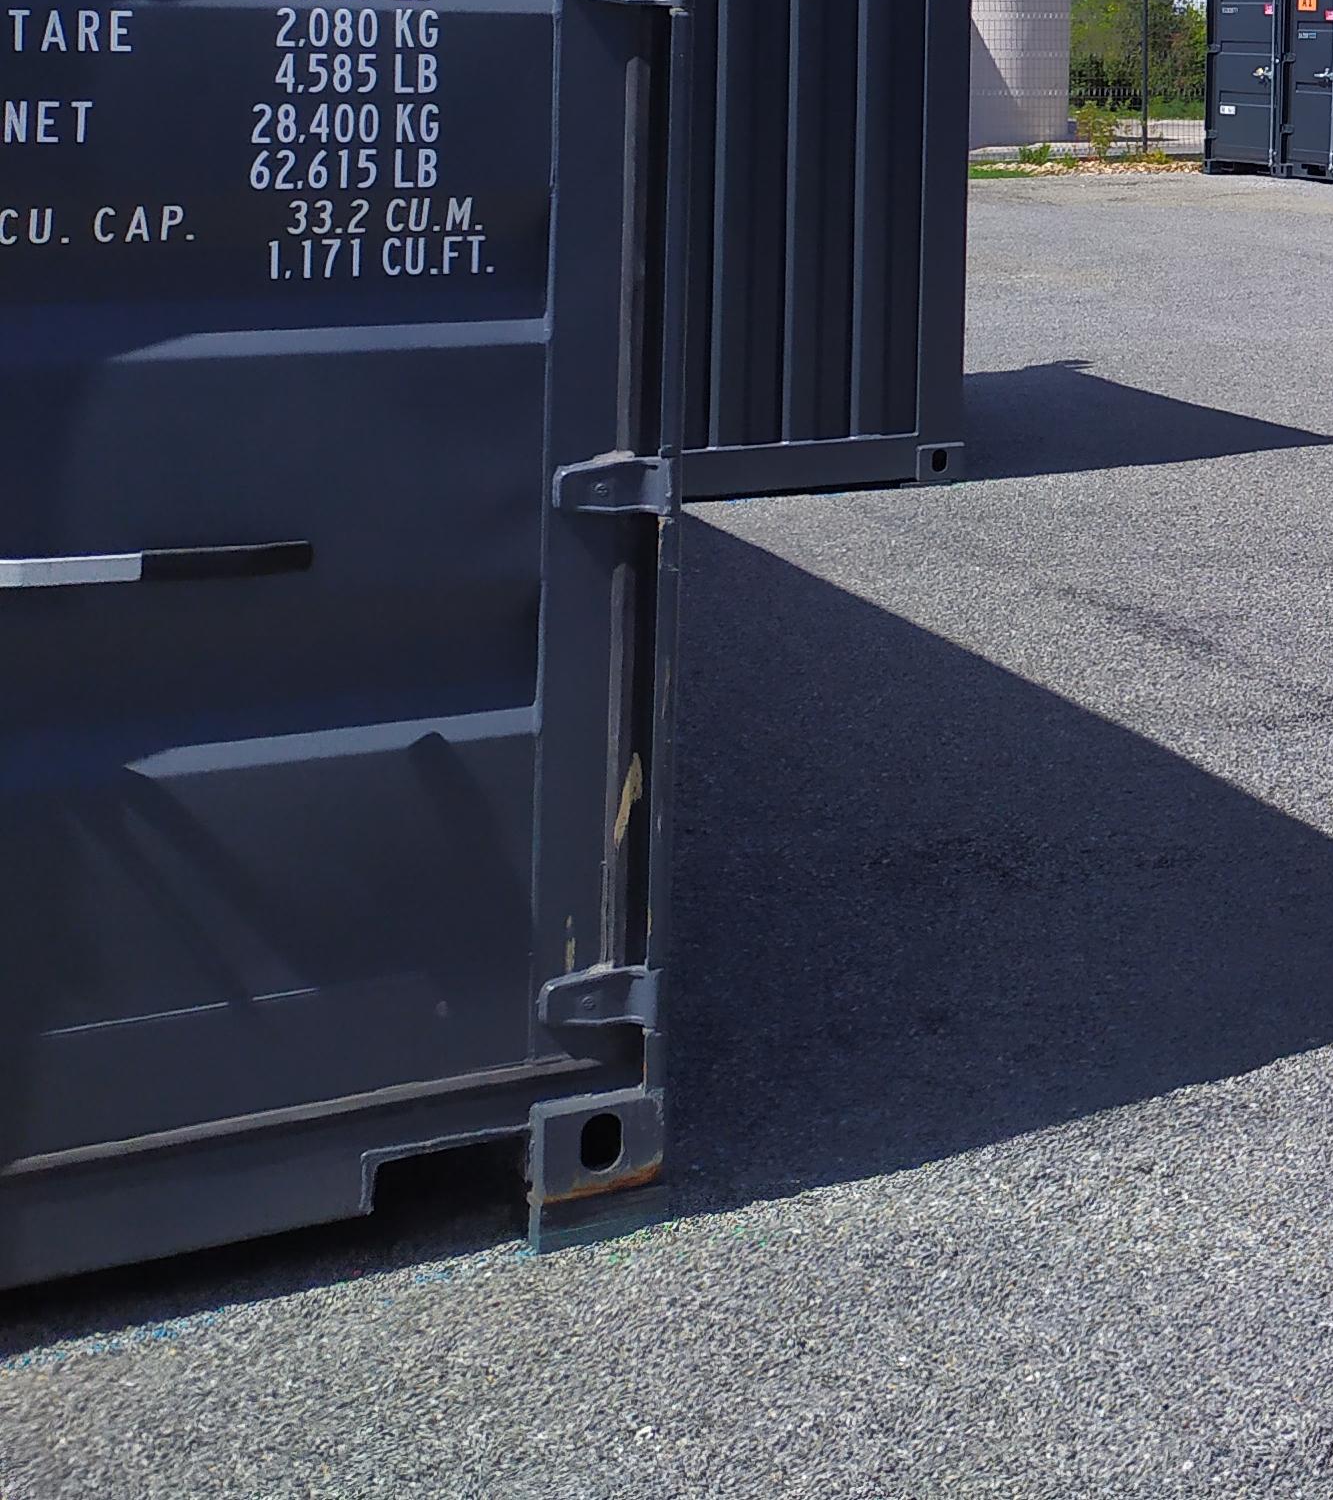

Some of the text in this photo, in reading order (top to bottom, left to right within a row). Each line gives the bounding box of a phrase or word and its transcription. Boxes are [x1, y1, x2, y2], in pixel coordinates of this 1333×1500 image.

[8, 9, 134, 53] TARE
[394, 8, 440, 49] KG
[393, 53, 438, 94] LB
[3, 101, 94, 145] NET
[395, 103, 440, 144] KG
[393, 149, 438, 189] LB
[0, 197, 484, 246] CU. CAP. 33.2 CU.M.
[382, 235, 496, 277] CU.FT.
